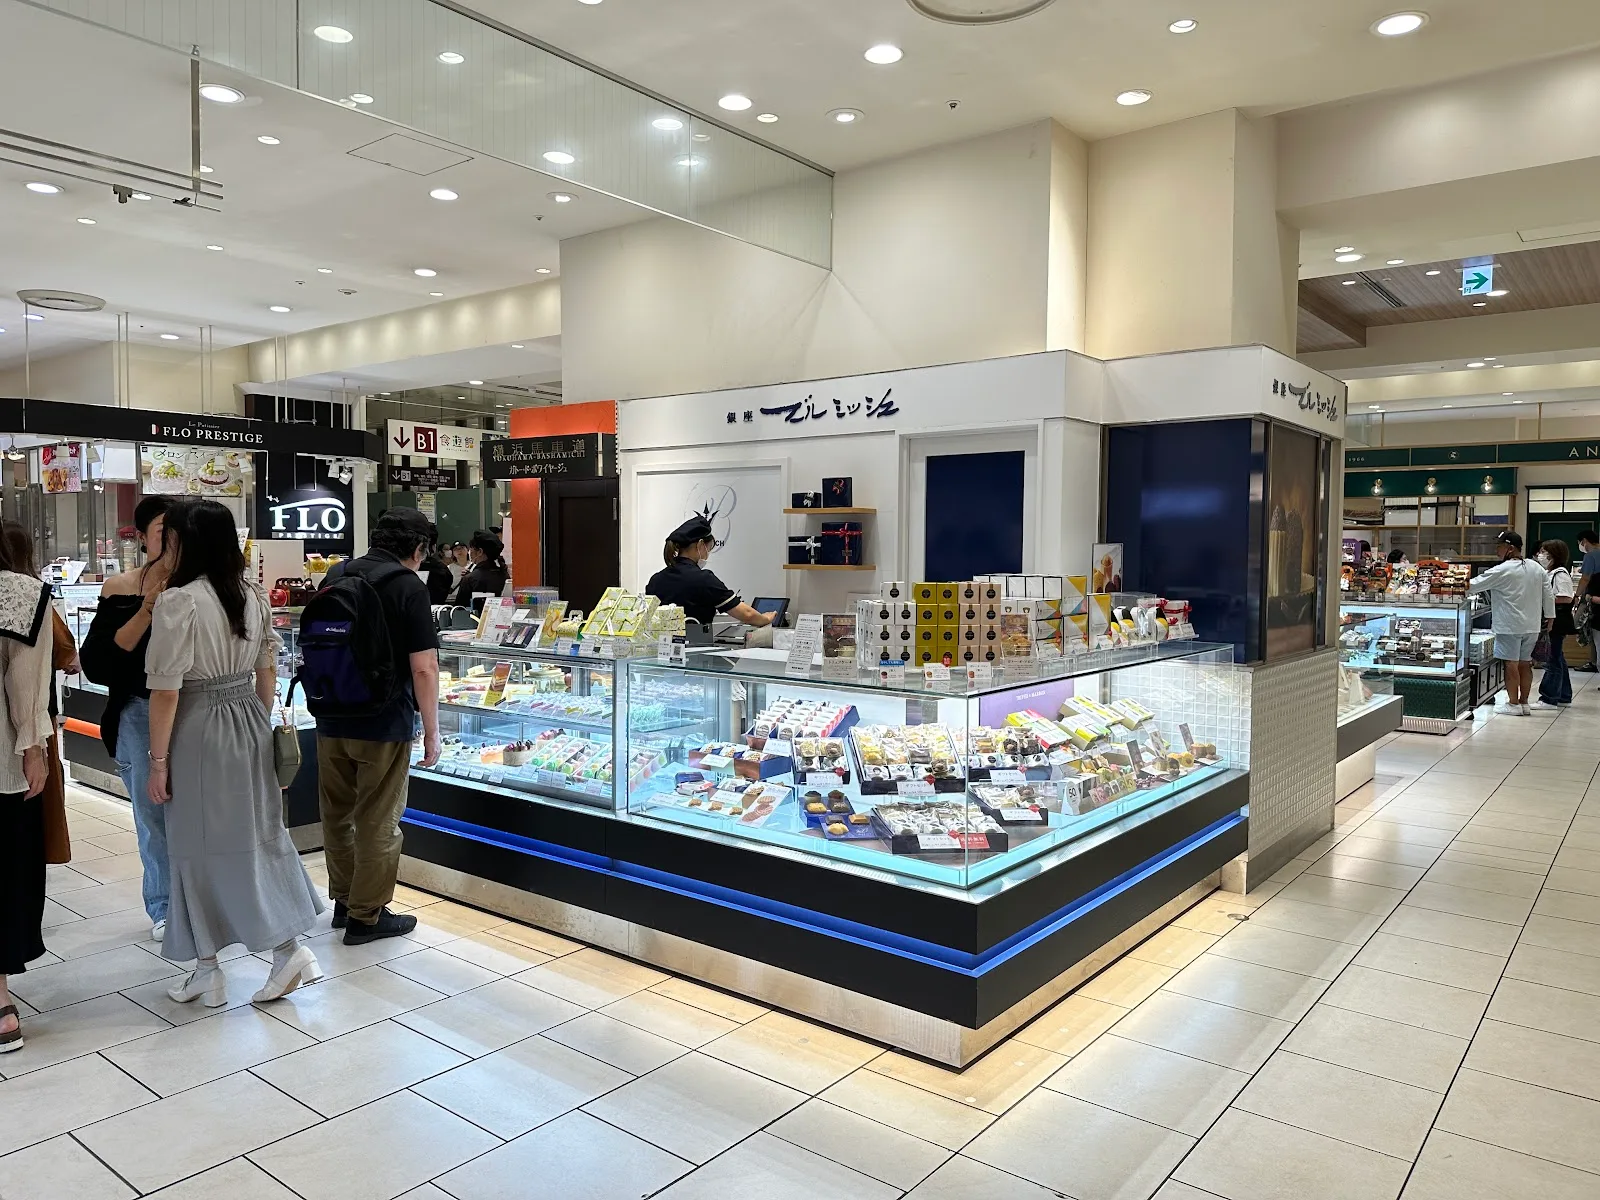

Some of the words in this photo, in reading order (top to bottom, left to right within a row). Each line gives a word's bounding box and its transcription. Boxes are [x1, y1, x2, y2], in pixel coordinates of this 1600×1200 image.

[726, 410, 753, 424] 銀座
[163, 426, 191, 438] FLO
[196, 429, 264, 444] PRESTIGE
[417, 431, 434, 451] B1
[492, 439, 585, 457] 横浜馬車道
[269, 498, 346, 532] FLO
